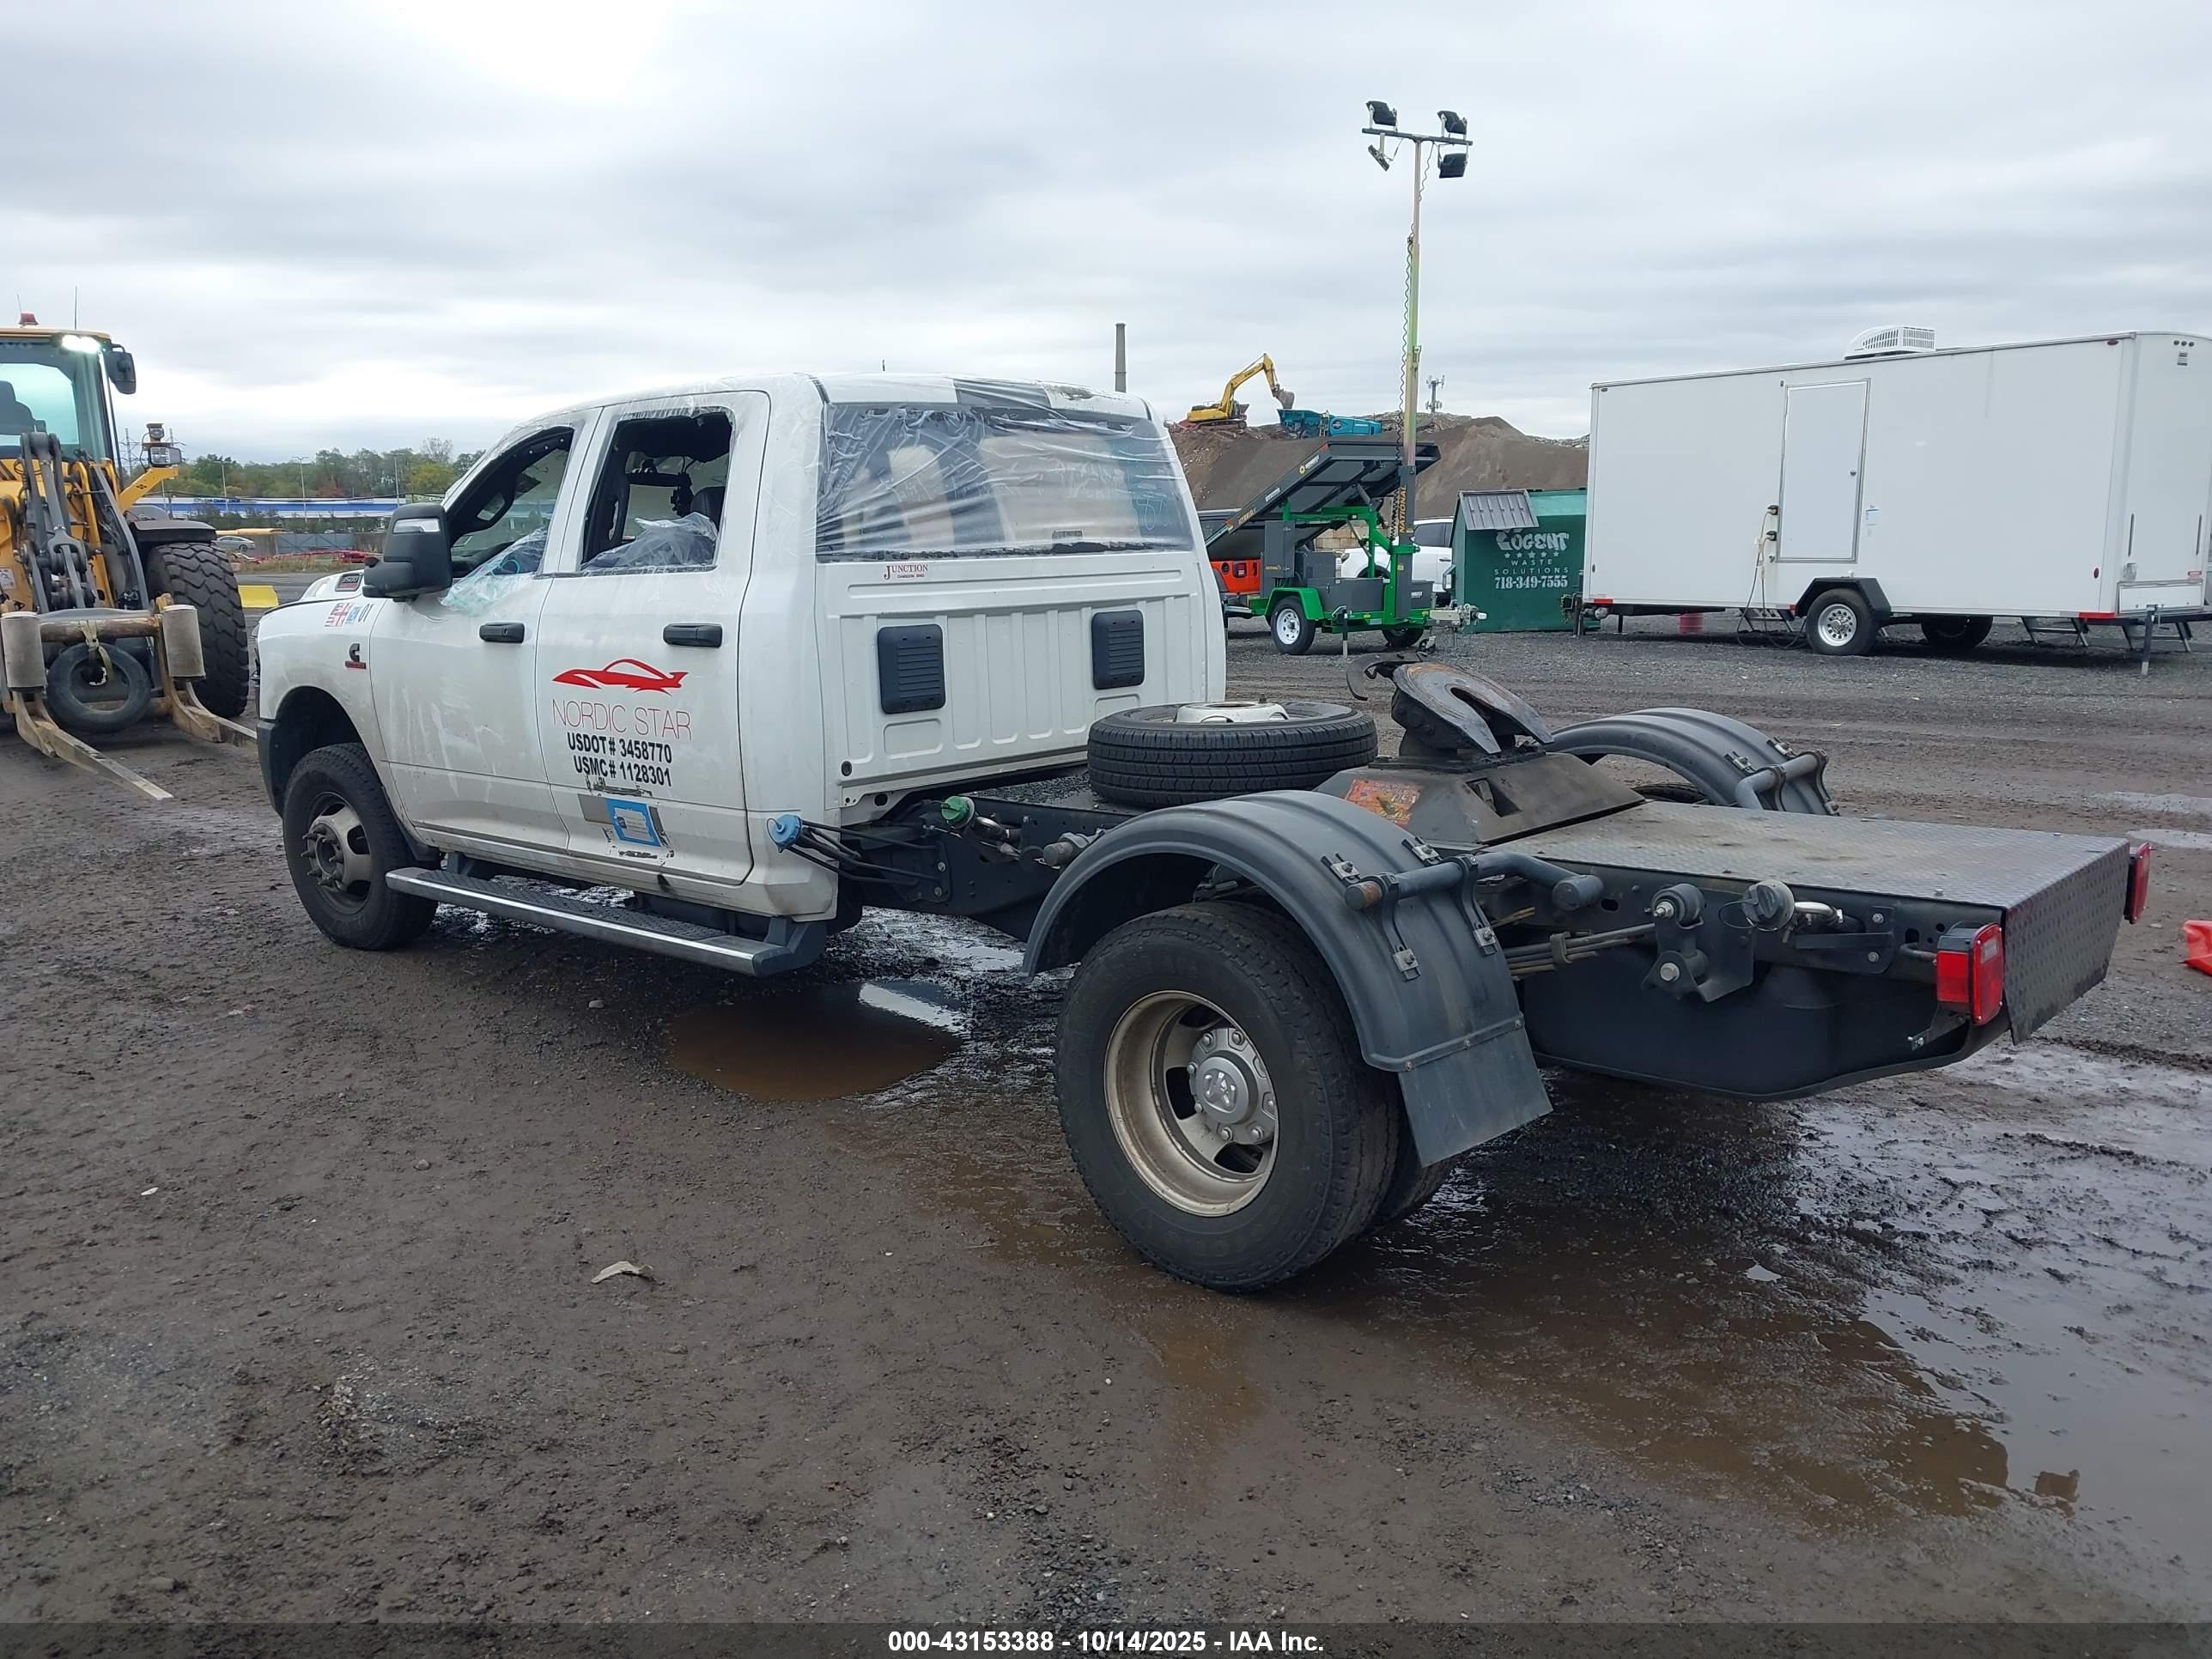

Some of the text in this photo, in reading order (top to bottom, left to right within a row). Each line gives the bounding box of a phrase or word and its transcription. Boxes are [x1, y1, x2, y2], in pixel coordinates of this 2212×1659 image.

[1497, 531, 1570, 551] COGENT
[884, 563, 928, 580] JUNCTION
[1494, 567, 1569, 575] SOLUTIONS
[1495, 575, 1568, 589] 718-349-7555
[552, 699, 692, 740] NORDIC STAR
[618, 738, 672, 763] 3458770
[619, 762, 672, 787] 1128301
